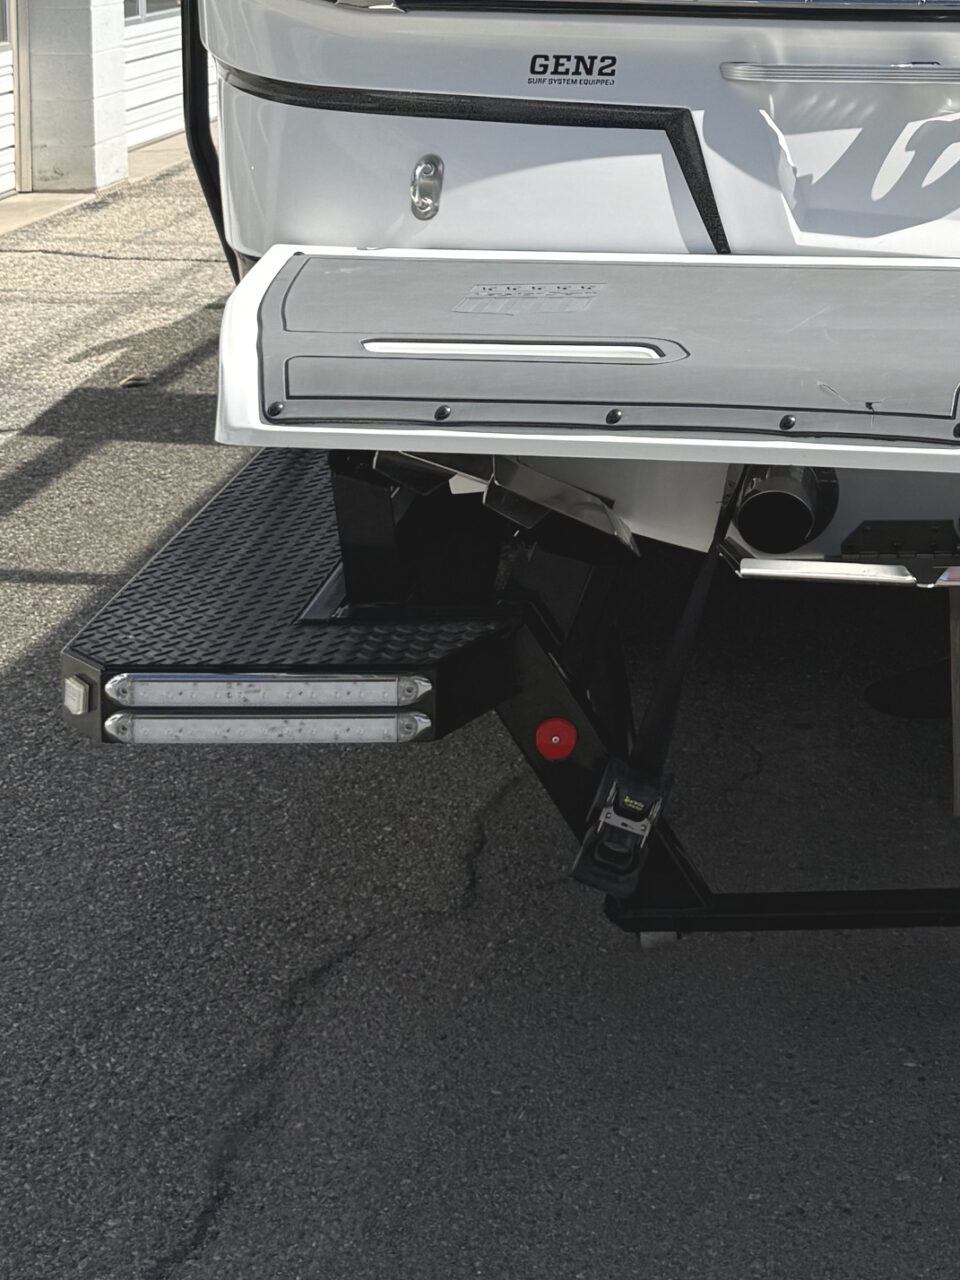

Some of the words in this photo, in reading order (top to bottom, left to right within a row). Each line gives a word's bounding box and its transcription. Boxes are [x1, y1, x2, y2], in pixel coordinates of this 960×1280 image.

[529, 54, 617, 76] GEN2
[527, 77, 547, 85] SURF
[548, 78, 578, 86] SYSTEM
